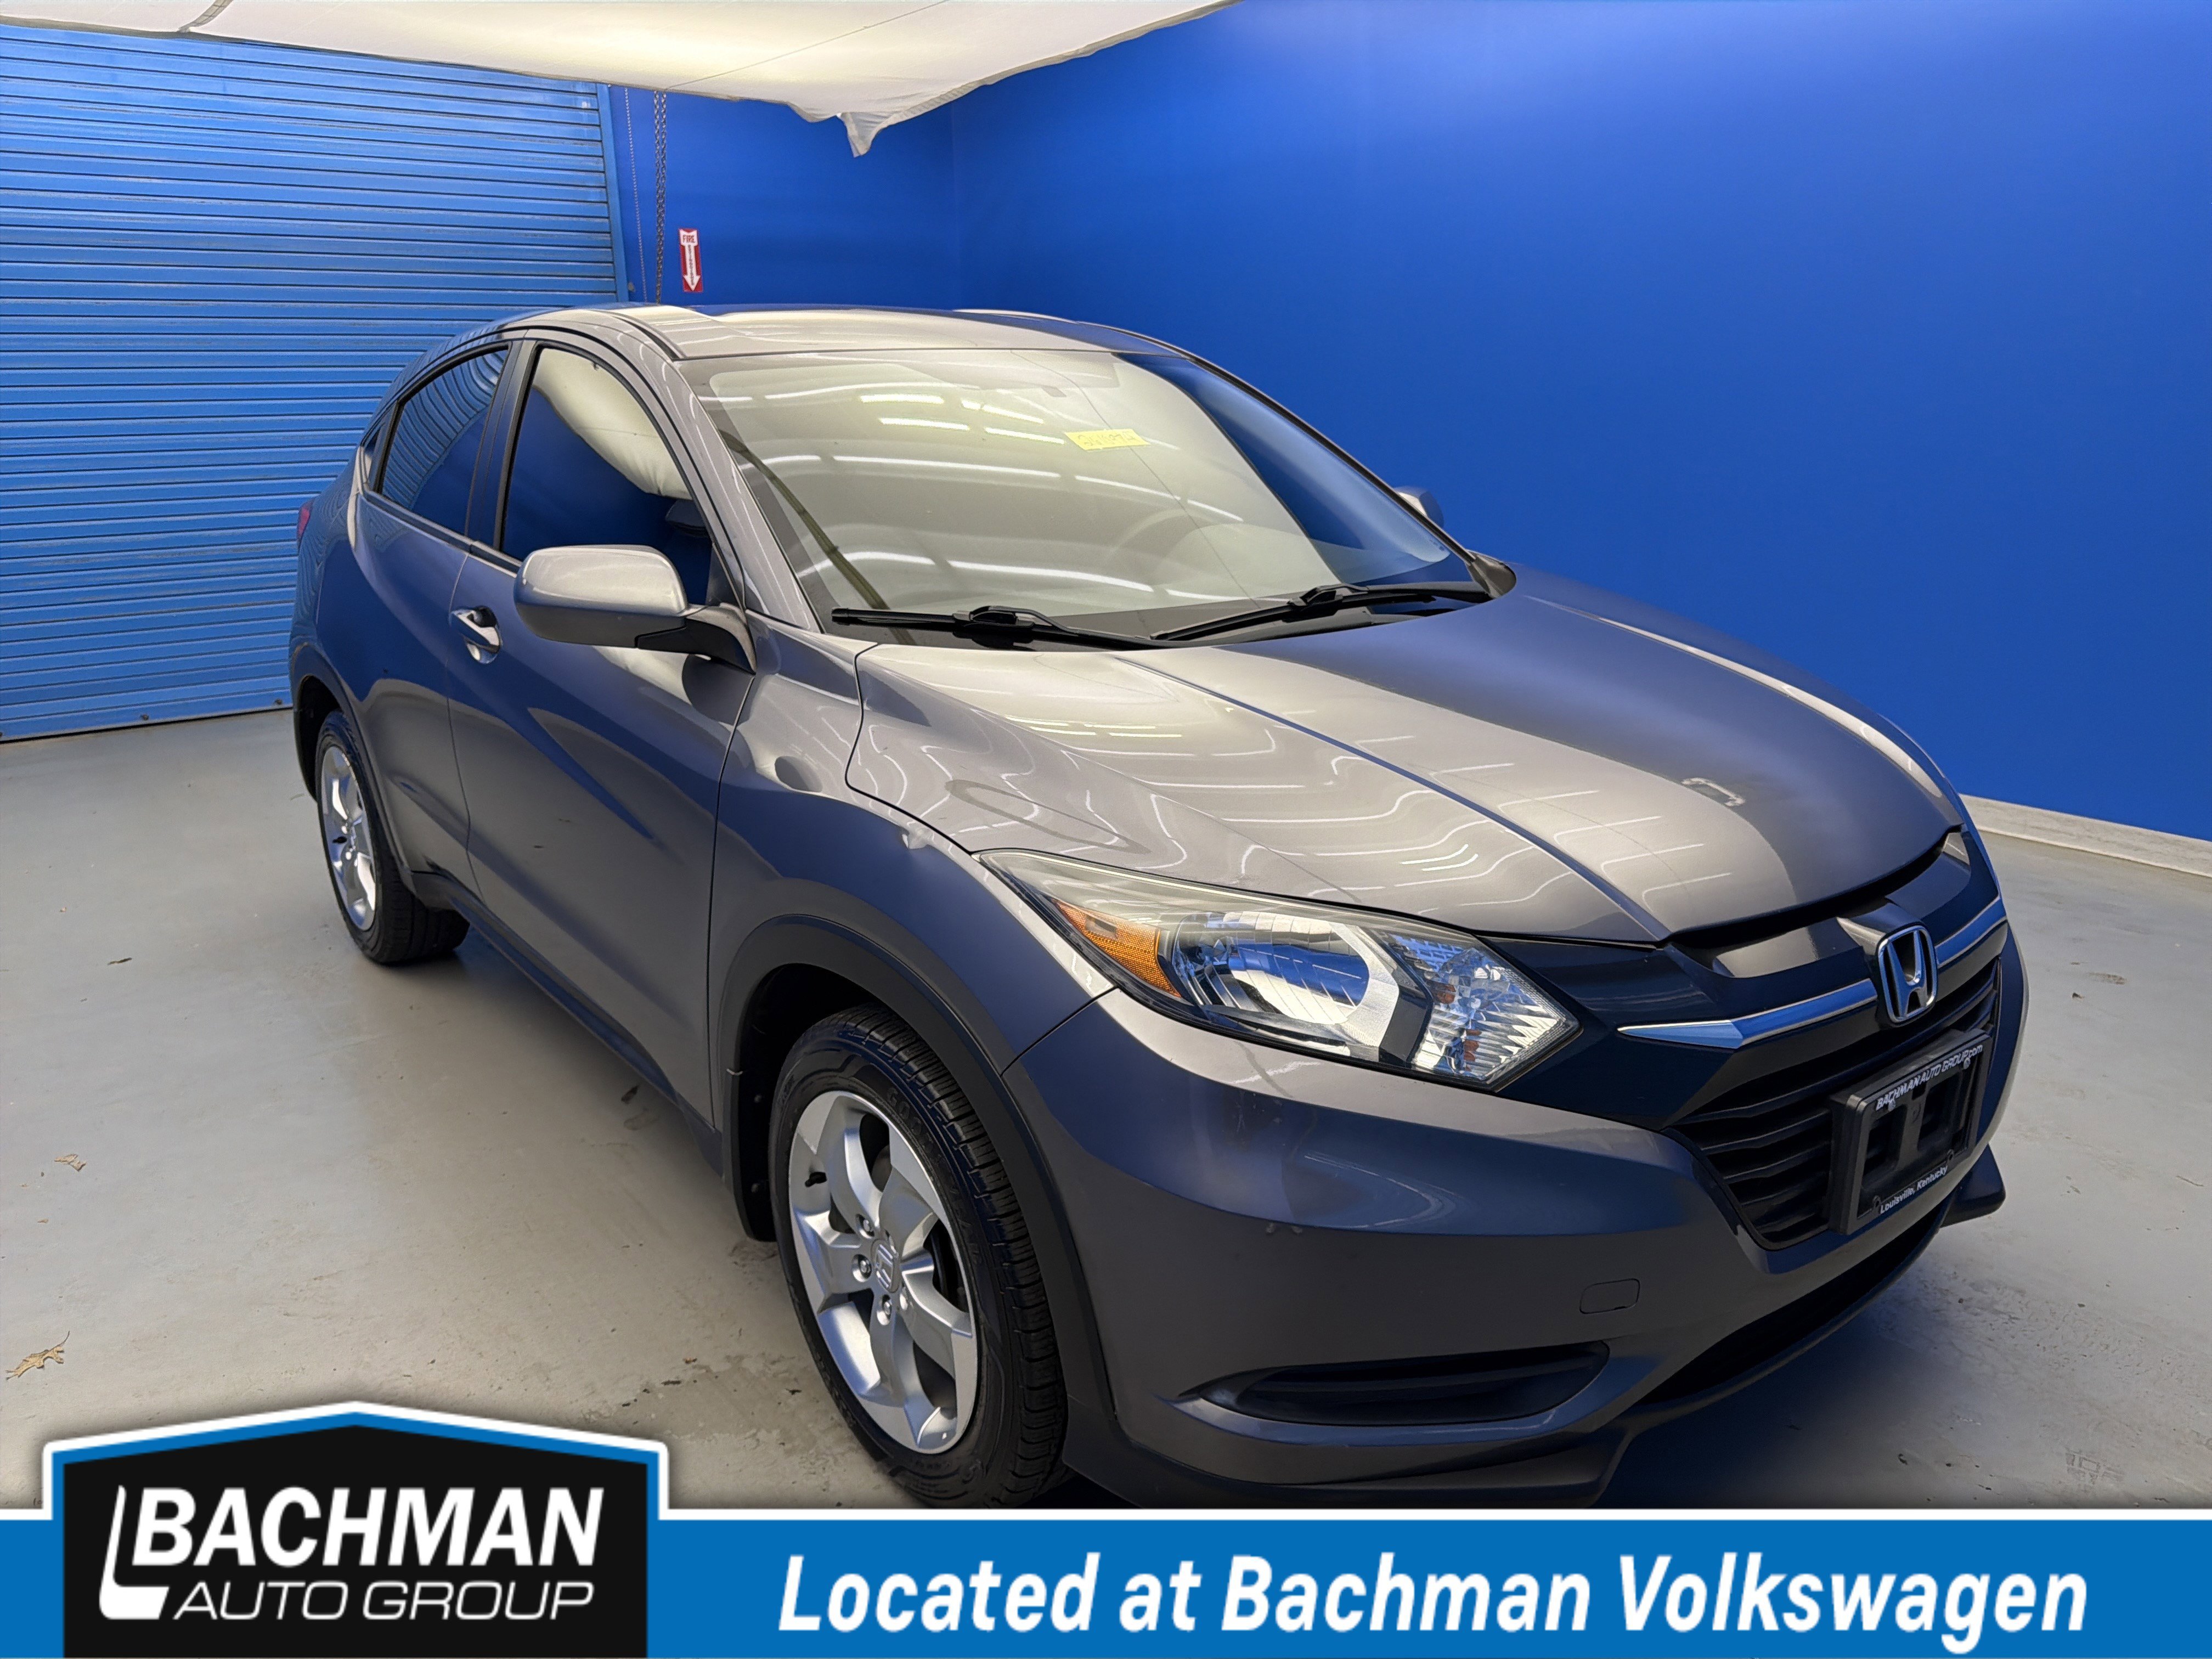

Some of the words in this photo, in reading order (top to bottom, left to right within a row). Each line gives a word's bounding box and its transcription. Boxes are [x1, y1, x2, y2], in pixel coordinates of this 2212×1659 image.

[1876, 1074, 1921, 1111] BACHMAN
[1880, 1187, 1915, 1215] Louisville,
[1916, 1165, 1948, 1191] Kentucky
